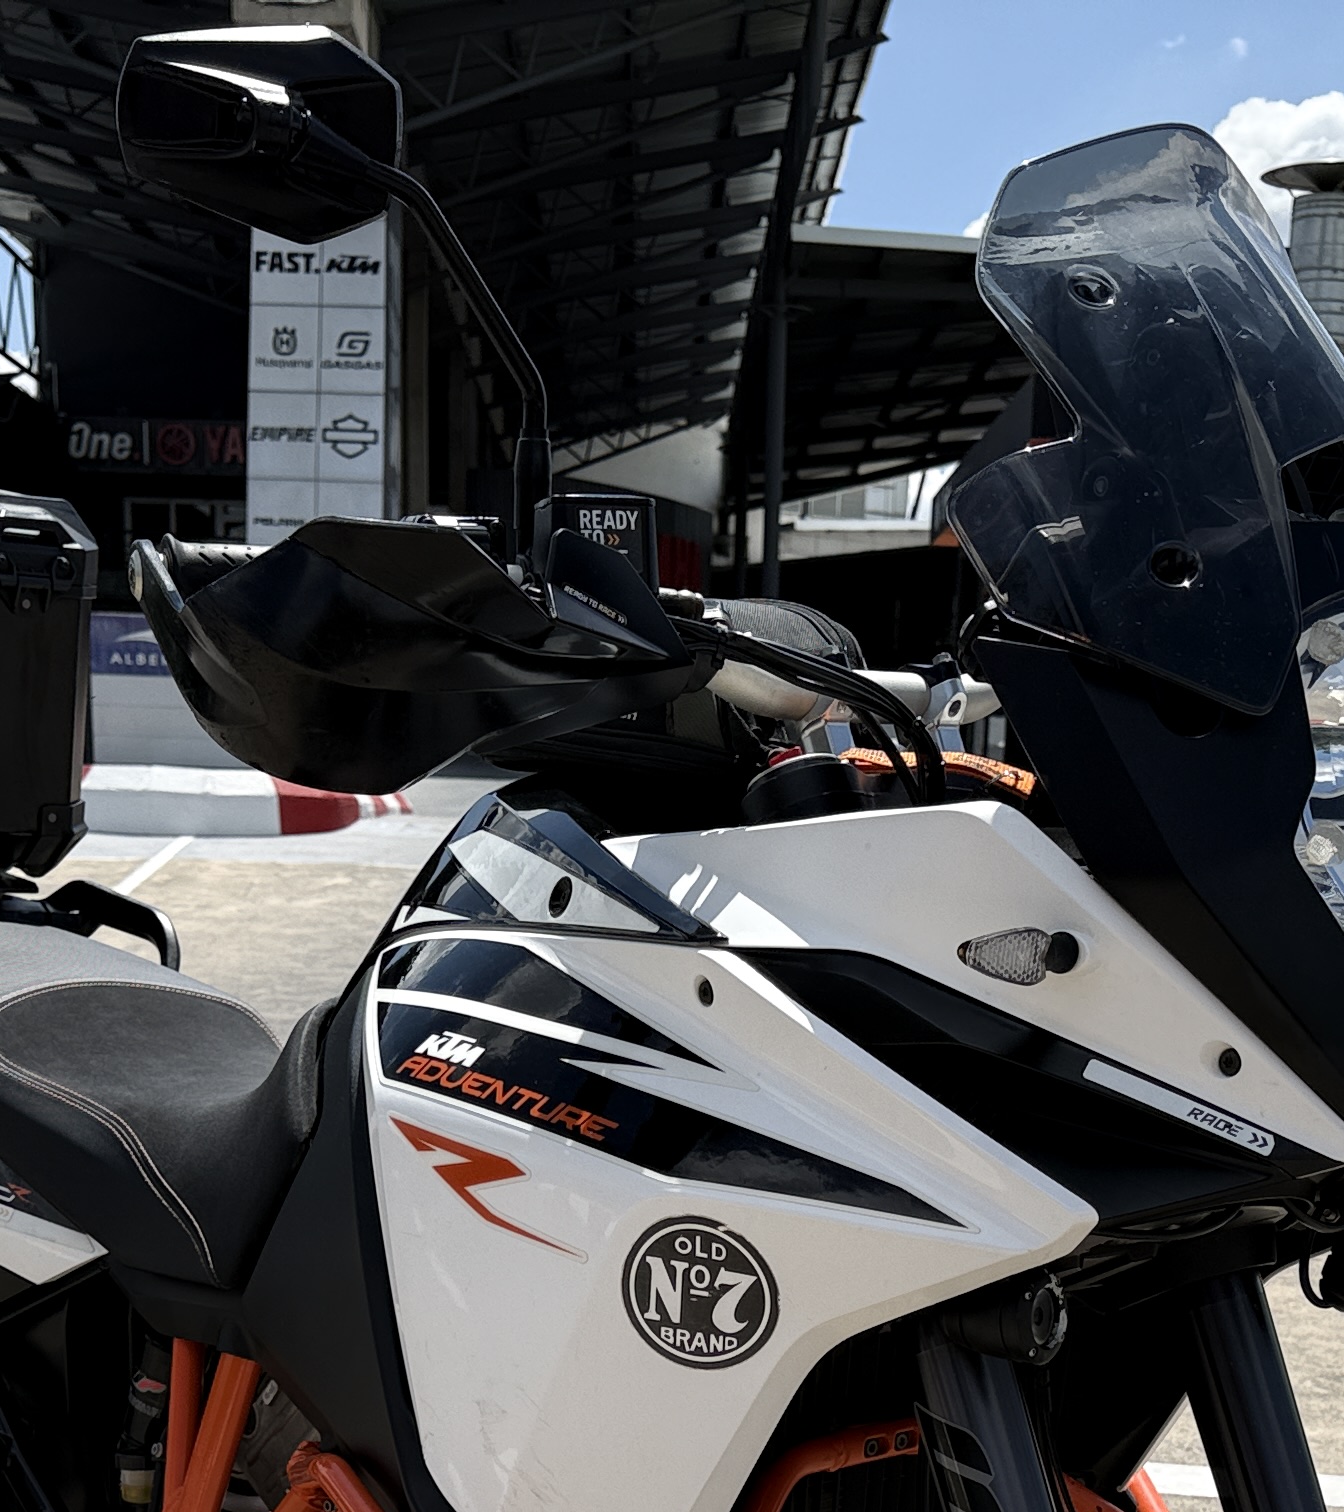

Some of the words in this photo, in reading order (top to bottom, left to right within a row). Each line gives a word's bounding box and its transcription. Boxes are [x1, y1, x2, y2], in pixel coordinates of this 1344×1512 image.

[325, 254, 381, 275] KTM
[578, 509, 638, 531] READY
[414, 1030, 486, 1068] KTM
[395, 1055, 620, 1142] ADVENTURE
[674, 1234, 728, 1262] OLD
[660, 1326, 738, 1354] BRAND
